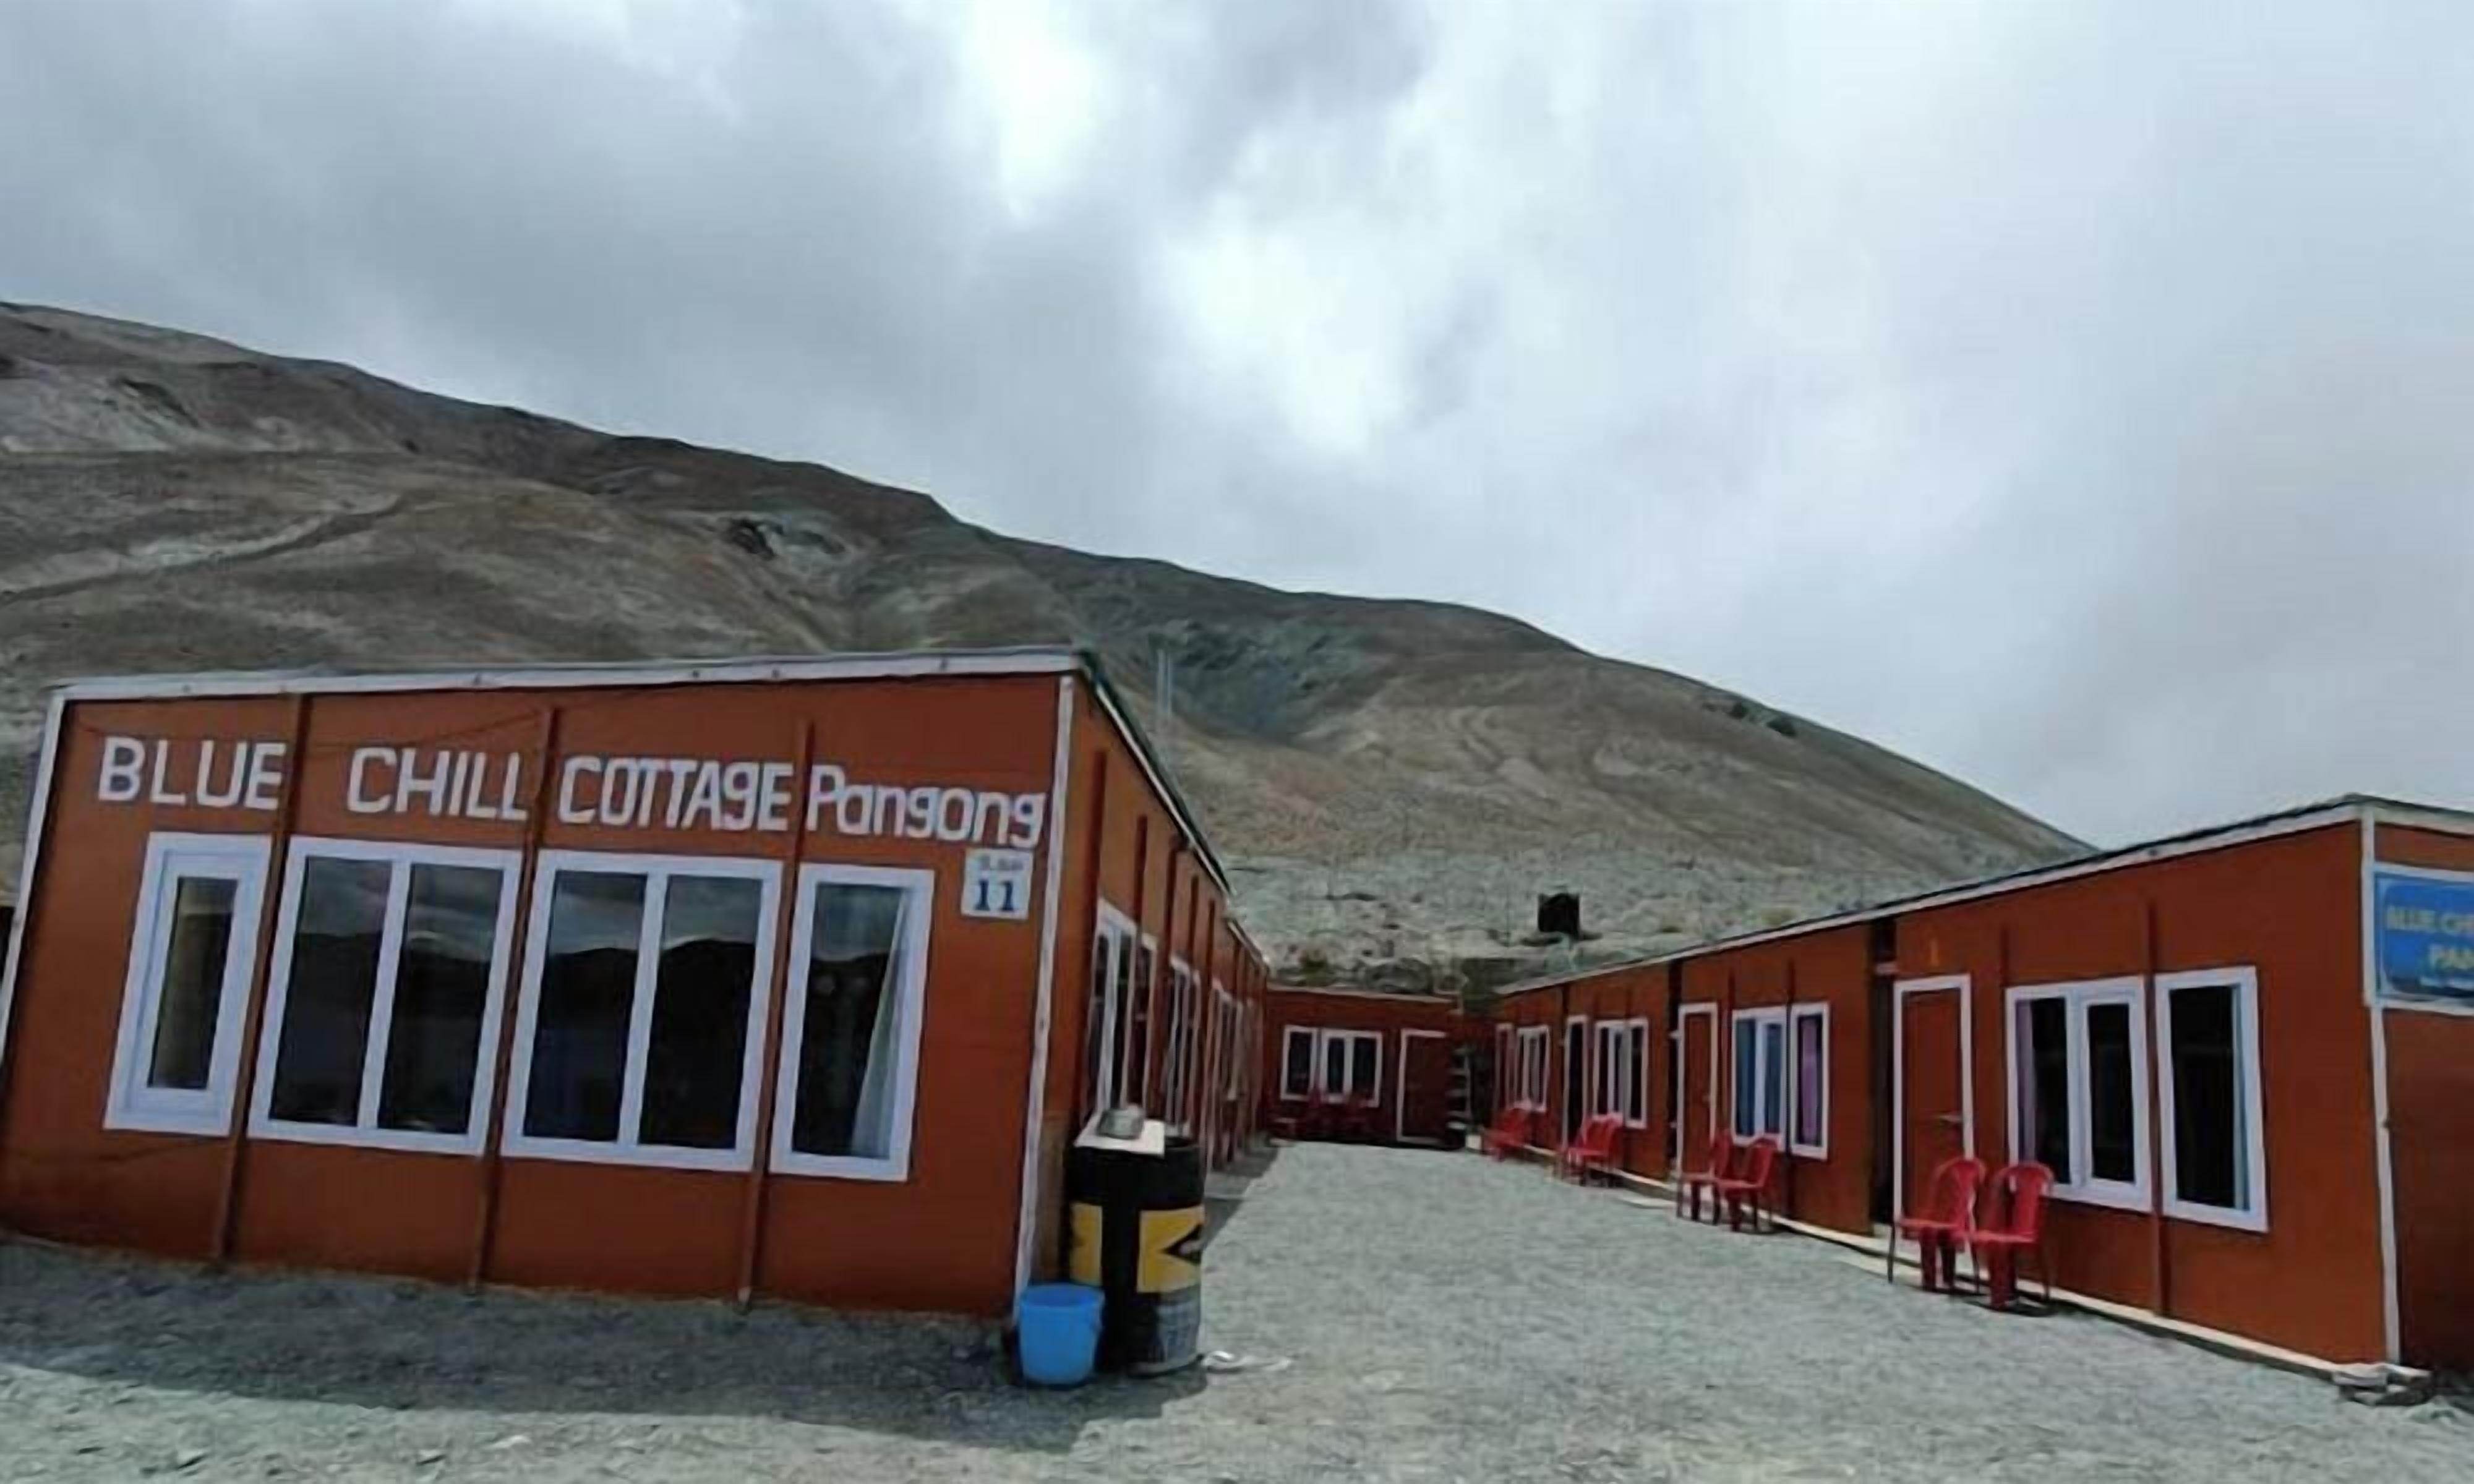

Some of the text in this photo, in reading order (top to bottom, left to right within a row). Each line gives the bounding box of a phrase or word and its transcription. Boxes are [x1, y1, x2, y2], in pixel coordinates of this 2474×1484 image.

[98, 736, 286, 811] BLUE
[346, 748, 528, 821] CHILL
[807, 764, 1045, 847] Pangong
[974, 879, 1016, 911] 11
